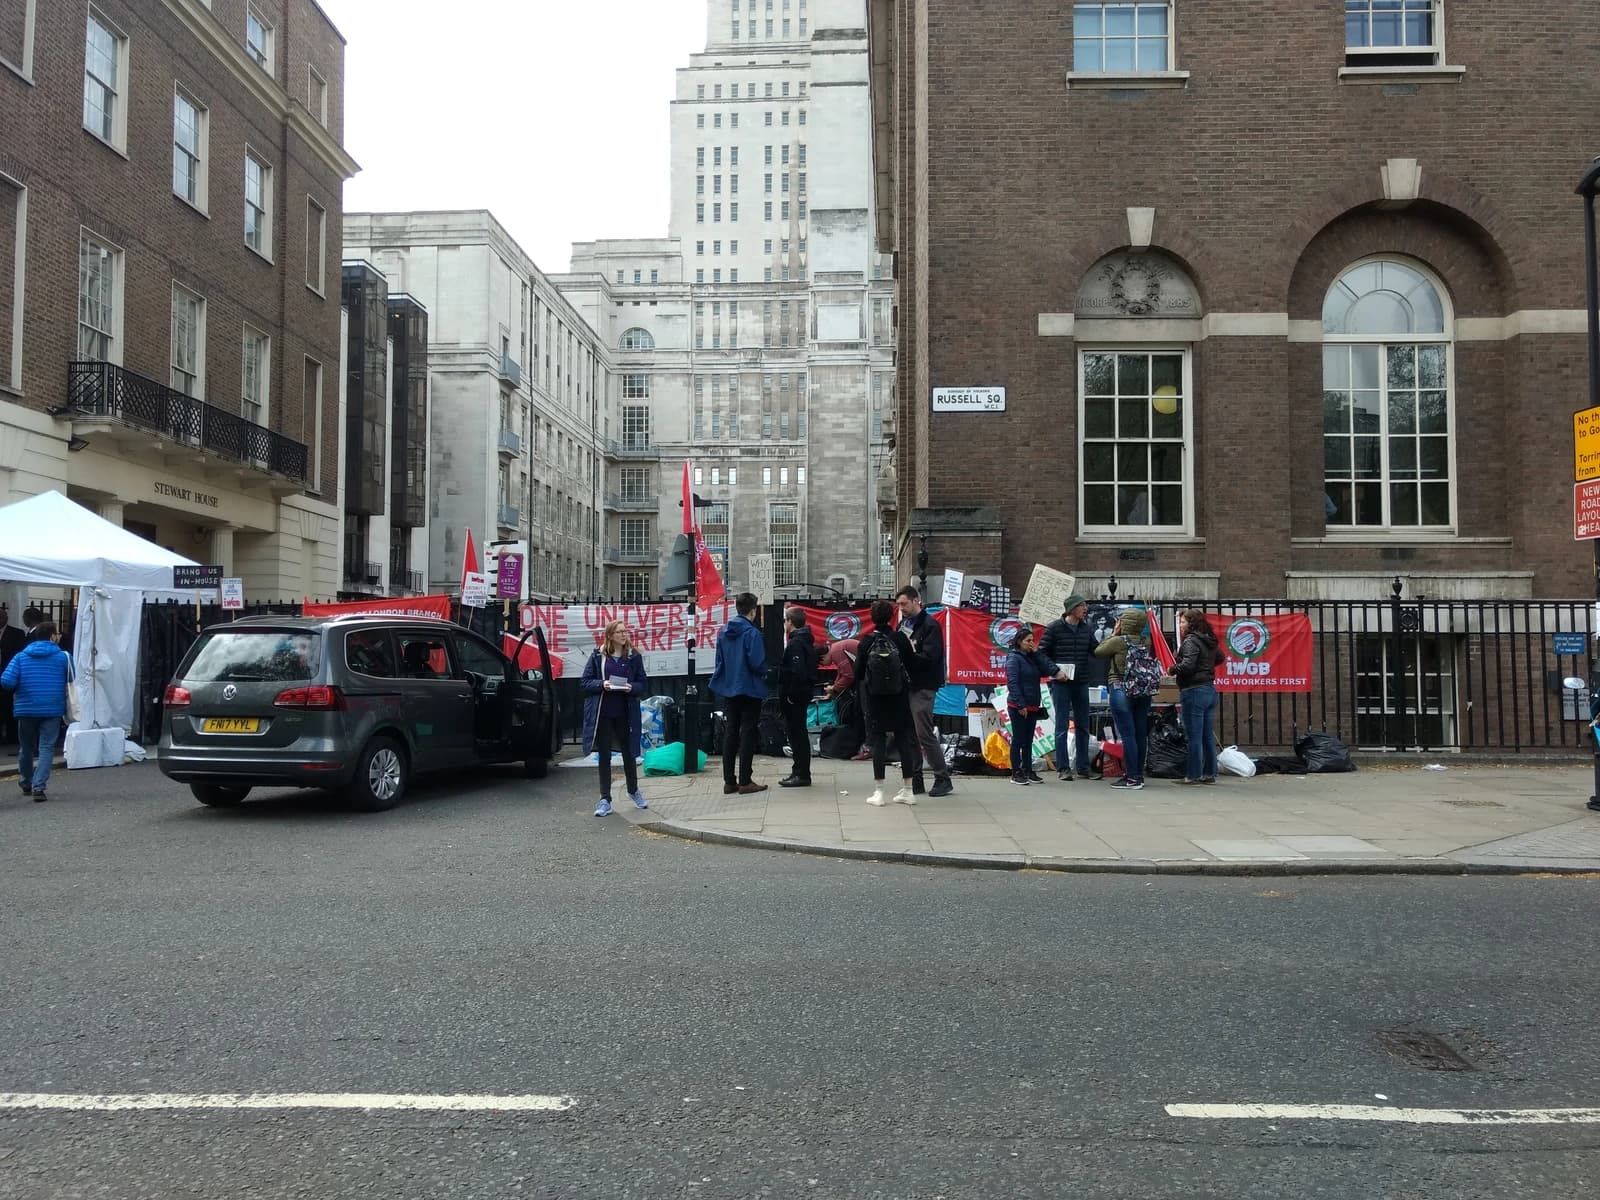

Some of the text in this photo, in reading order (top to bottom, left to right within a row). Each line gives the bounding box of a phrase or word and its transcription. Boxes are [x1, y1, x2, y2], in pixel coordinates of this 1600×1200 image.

[937, 394, 982, 404] RUSSELL
[1578, 415, 1589, 426] No
[1578, 429, 1587, 439] to
[1578, 466, 1596, 477] from
[154, 482, 219, 508] STEWART HOUSE
[1582, 486, 1600, 497] NEW
[1580, 521, 1600, 533] HEA
[750, 559, 770, 568] WHY
[176, 568, 201, 576] BRING
[752, 569, 771, 580] NOT
[180, 577, 219, 586] IN-HOUSE
[752, 580, 771, 590] TALK
[969, 584, 980, 606] JUST
[407, 609, 442, 619] BRANCH
[521, 605, 568, 629] ONE
[957, 670, 994, 678] PUTTING
[1233, 678, 1277, 686] WORKERS
[1280, 678, 1307, 686] FIRST
[209, 719, 252, 730] FN17 YYL
